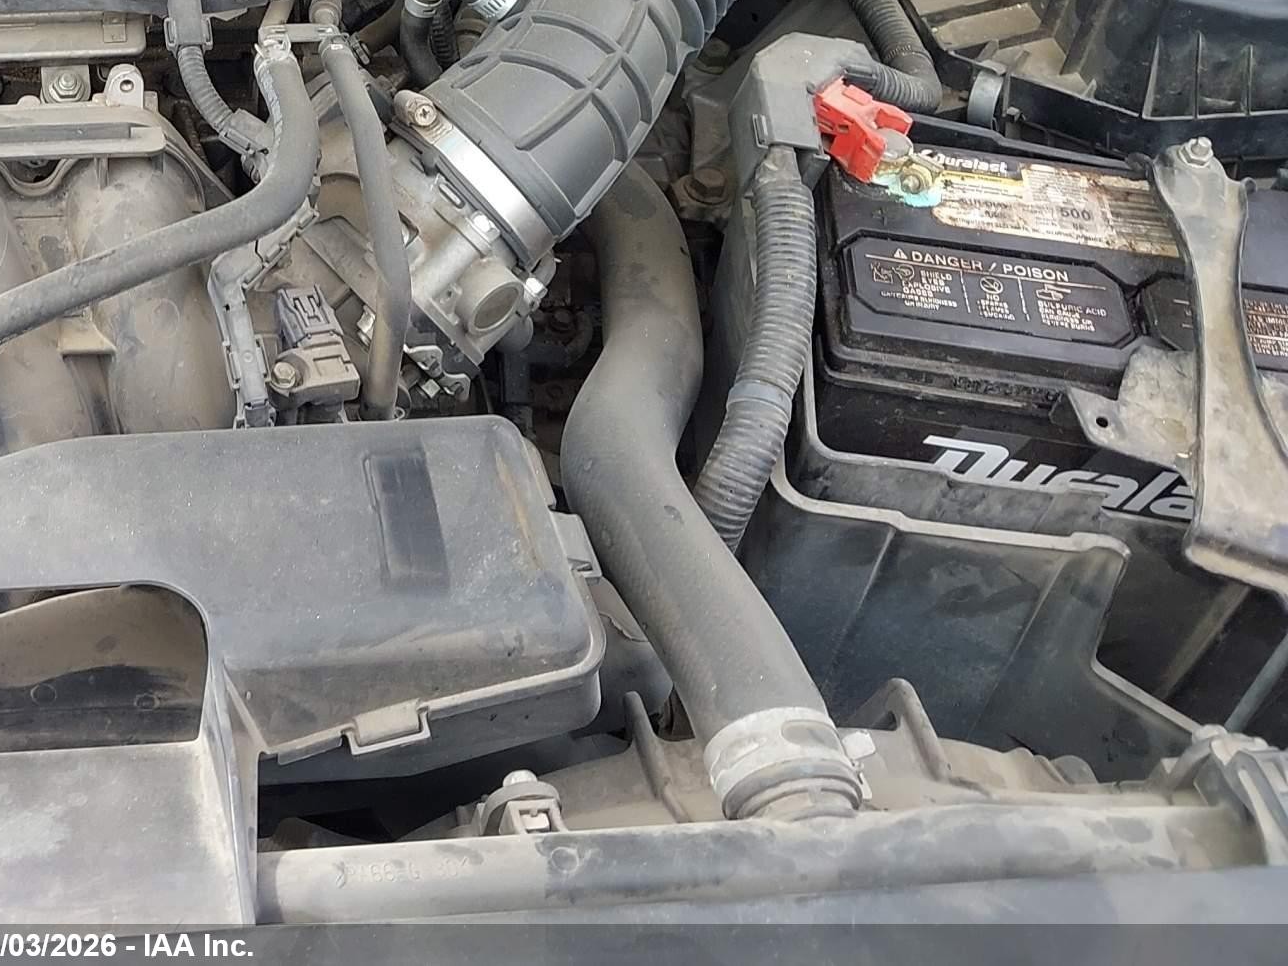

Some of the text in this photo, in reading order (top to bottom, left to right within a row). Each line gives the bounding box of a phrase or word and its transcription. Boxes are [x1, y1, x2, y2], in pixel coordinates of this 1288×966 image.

[912, 251, 983, 271] DANGER
[1003, 265, 1069, 282] POISON
[1085, 307, 1107, 317] ACID
